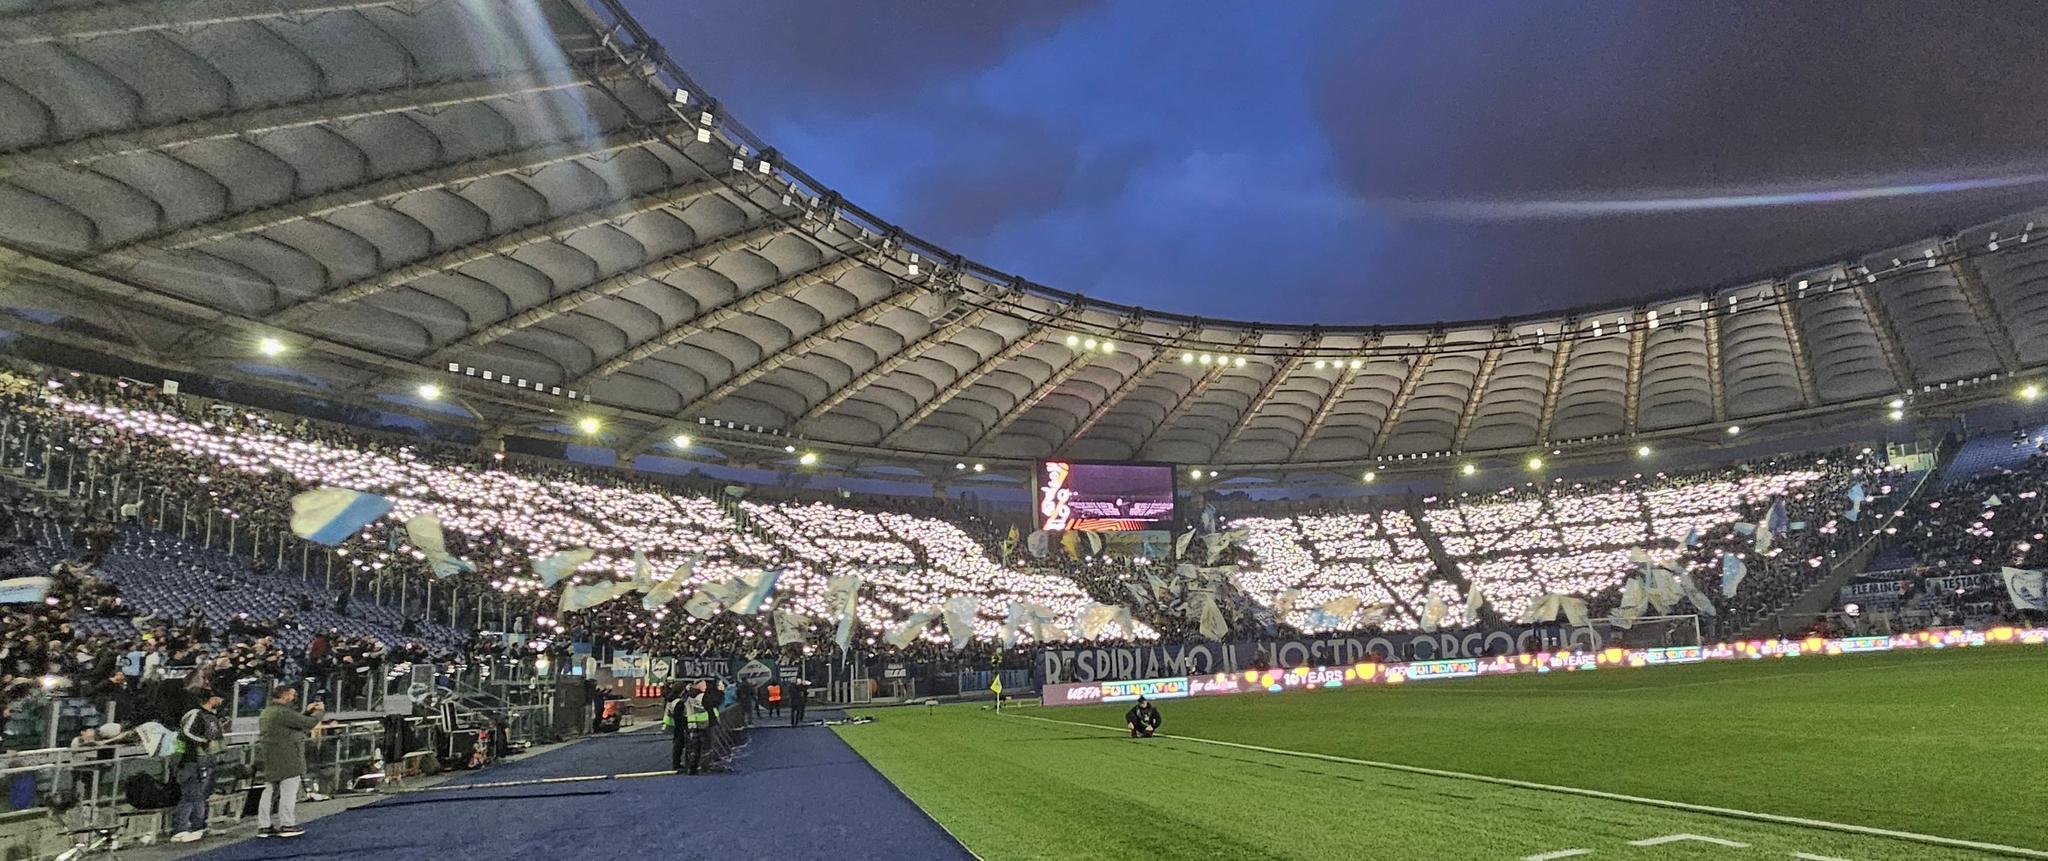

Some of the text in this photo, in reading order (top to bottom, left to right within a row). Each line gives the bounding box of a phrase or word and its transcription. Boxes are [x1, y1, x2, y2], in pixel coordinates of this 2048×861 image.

[1852, 581, 1900, 595] FLEMING
[1411, 661, 1476, 675] OUNDATION
[1299, 670, 1343, 684] YEARS
[1067, 686, 1100, 700] UEFA
[1102, 680, 1187, 697] FOUNDATION
[1189, 679, 1203, 697] for
